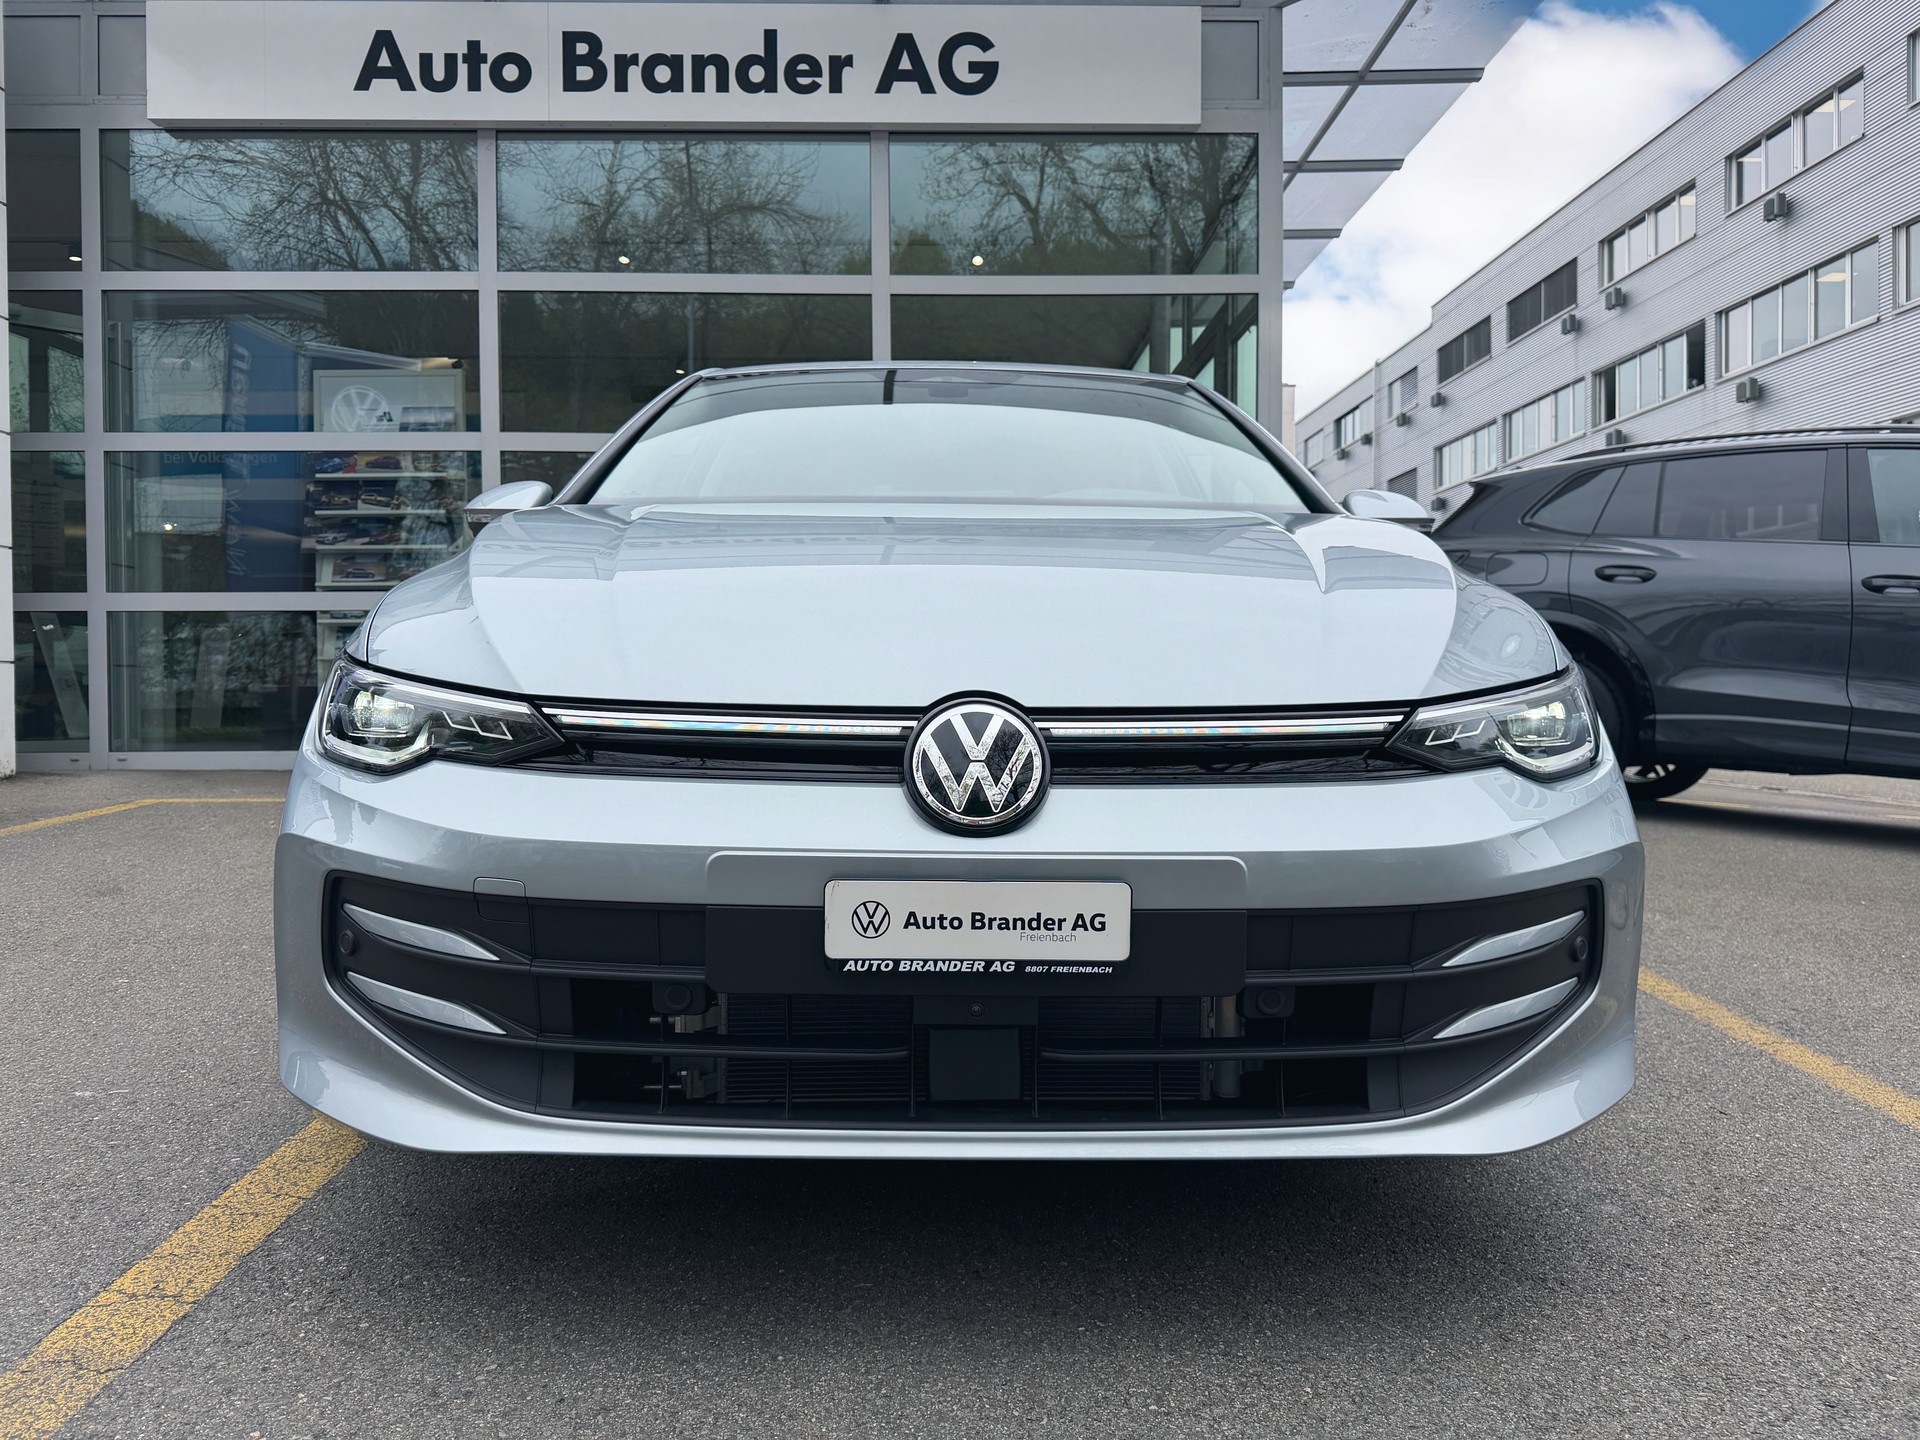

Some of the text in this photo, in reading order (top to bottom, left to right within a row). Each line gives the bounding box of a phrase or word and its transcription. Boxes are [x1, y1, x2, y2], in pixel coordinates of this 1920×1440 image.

[354, 29, 1000, 96] Auto Brander AG
[189, 452, 278, 466] Volkswagen
[903, 911, 1107, 932] Auto Brander AG
[1020, 932, 1077, 943] Freienbach
[843, 960, 1113, 974] AUTO BRANDER AG 8807 FREIENBACH
